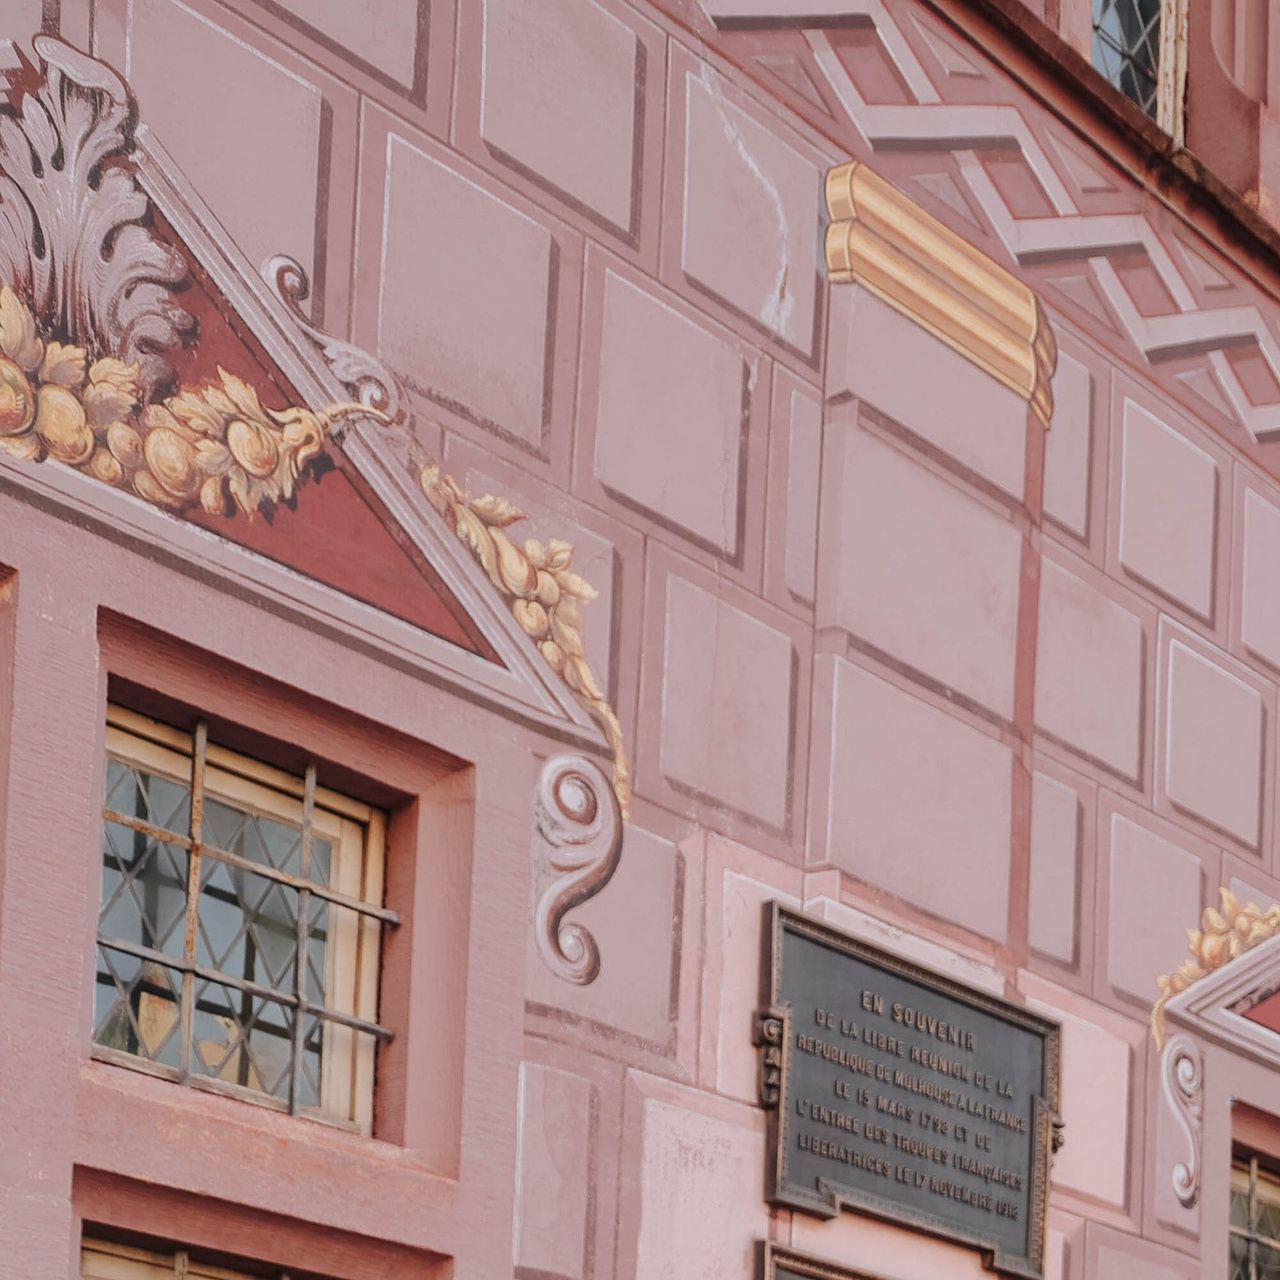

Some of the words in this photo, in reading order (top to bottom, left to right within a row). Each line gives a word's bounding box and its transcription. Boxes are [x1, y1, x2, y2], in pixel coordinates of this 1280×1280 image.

[816, 1009, 834, 1028] DE
[841, 1019, 857, 1038] LA
[864, 1027, 905, 1055] LIBRE
[911, 1046, 971, 1082] REUNION
[975, 1071, 991, 1090] DE
[998, 1080, 1013, 1098] LA
[862, 990, 884, 1015] EN
[892, 1003, 975, 1051] SOUVENIR
[798, 1033, 873, 1075] REPUBLIQUE
[876, 1063, 891, 1081] DE
[894, 1070, 955, 1107] MULHOUSE
[835, 1080, 850, 1098] LE
[877, 1096, 913, 1121] MARS
[954, 1125, 967, 1142] ET
[975, 1132, 991, 1151] DE
[865, 1123, 890, 1145] DES
[894, 1133, 950, 1166] TROUPES
[798, 1132, 891, 1176] LIBERATRICES
[895, 1164, 911, 1183] LE
[914, 1171, 927, 1188] 17
[930, 1176, 991, 1212] NOVEMBRE
